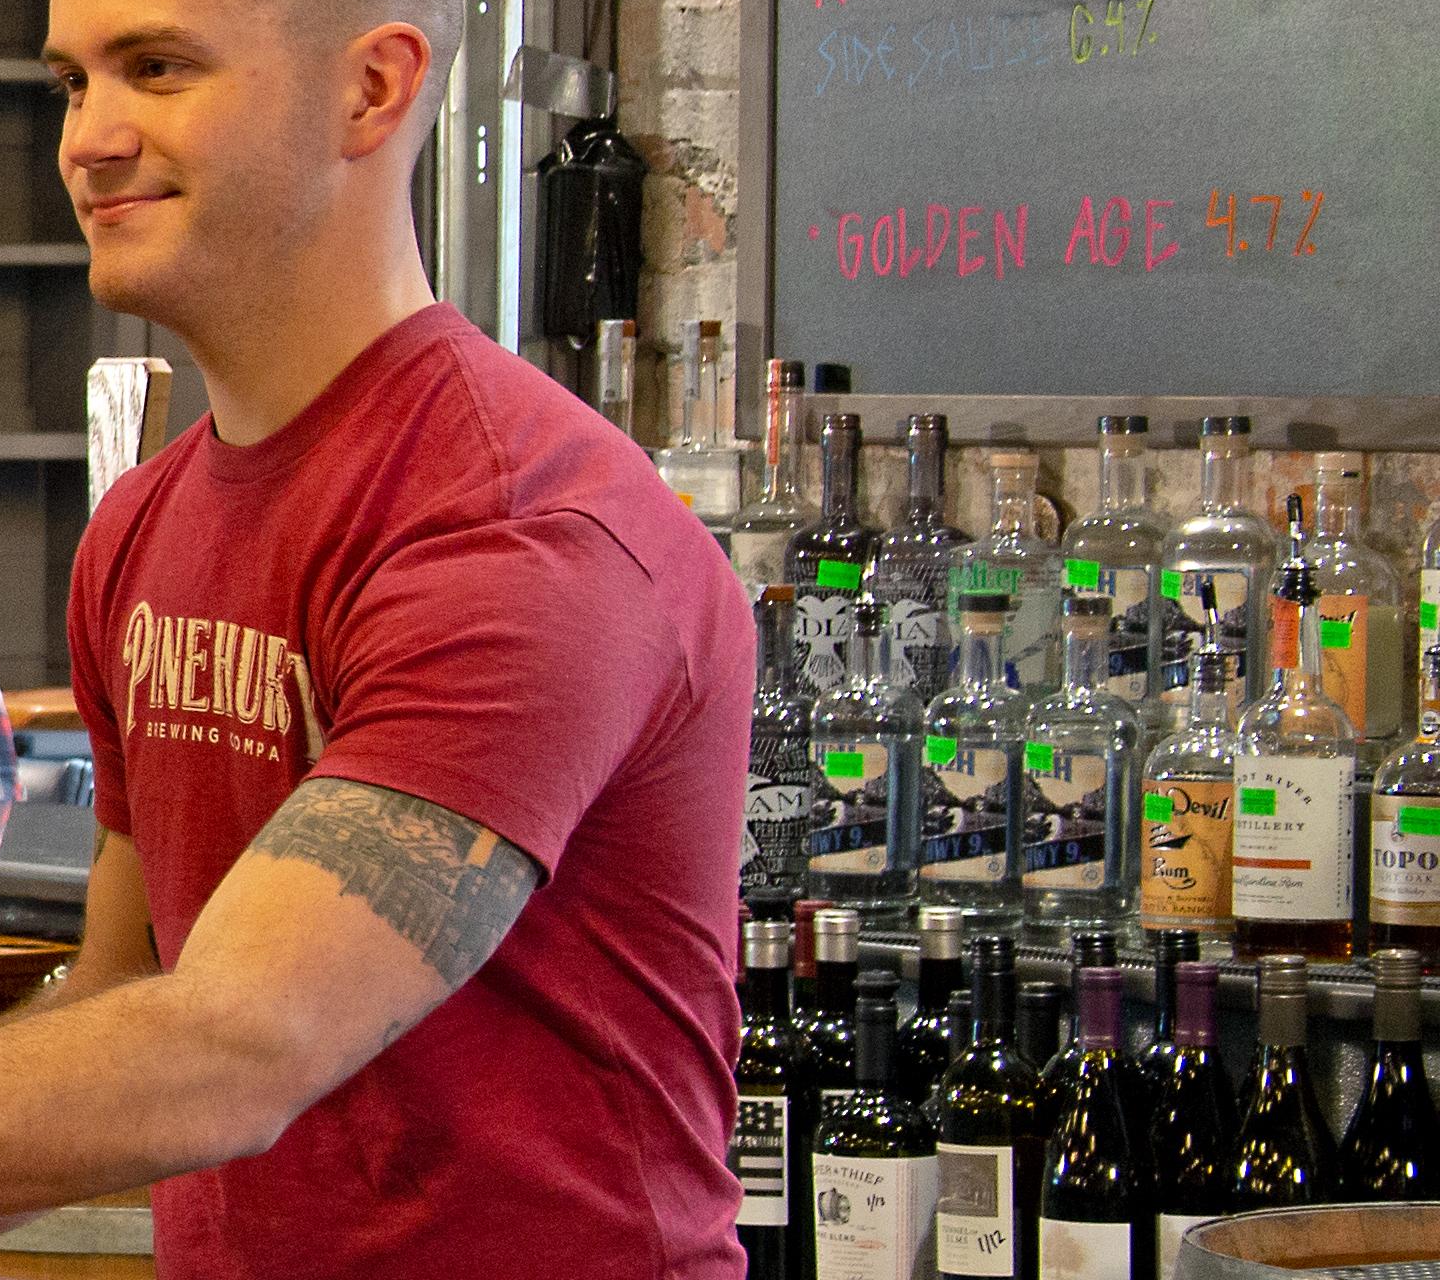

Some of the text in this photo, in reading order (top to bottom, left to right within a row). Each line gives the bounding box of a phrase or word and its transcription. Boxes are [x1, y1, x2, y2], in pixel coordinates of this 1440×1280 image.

[815, 22, 897, 96] SIDE
[836, 188, 1326, 281] GOLDEN AGE 4.7%
[1265, 774, 1313, 808] RIVER
[811, 826, 862, 854] HWY 9
[926, 833, 982, 862] HWY 9
[1066, 842, 1080, 862] 9
[977, 1230, 1007, 1255] 1/12
